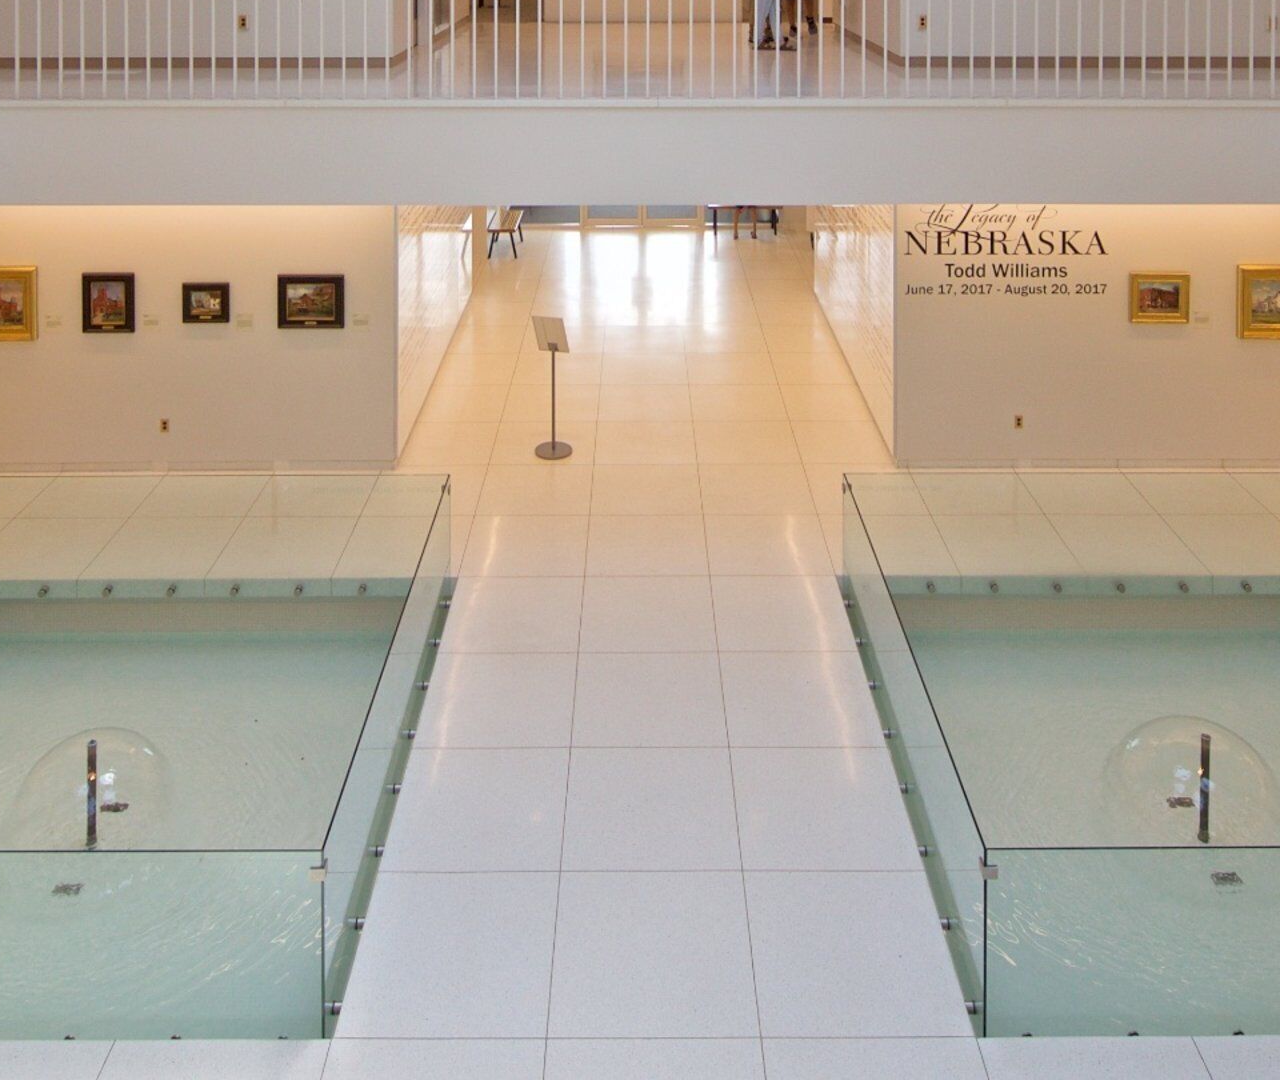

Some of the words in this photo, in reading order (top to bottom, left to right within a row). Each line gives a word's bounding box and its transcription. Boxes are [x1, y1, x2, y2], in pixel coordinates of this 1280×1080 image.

[904, 230, 1109, 256] NEBRASKA
[945, 263, 986, 278] Todd
[992, 263, 1068, 278] Williams
[905, 283, 934, 295] June
[937, 283, 957, 297] 17,
[961, 283, 993, 295] 2017
[1004, 283, 1047, 297] August
[1051, 283, 1070, 297] 20,
[1075, 283, 1108, 295] 2017
